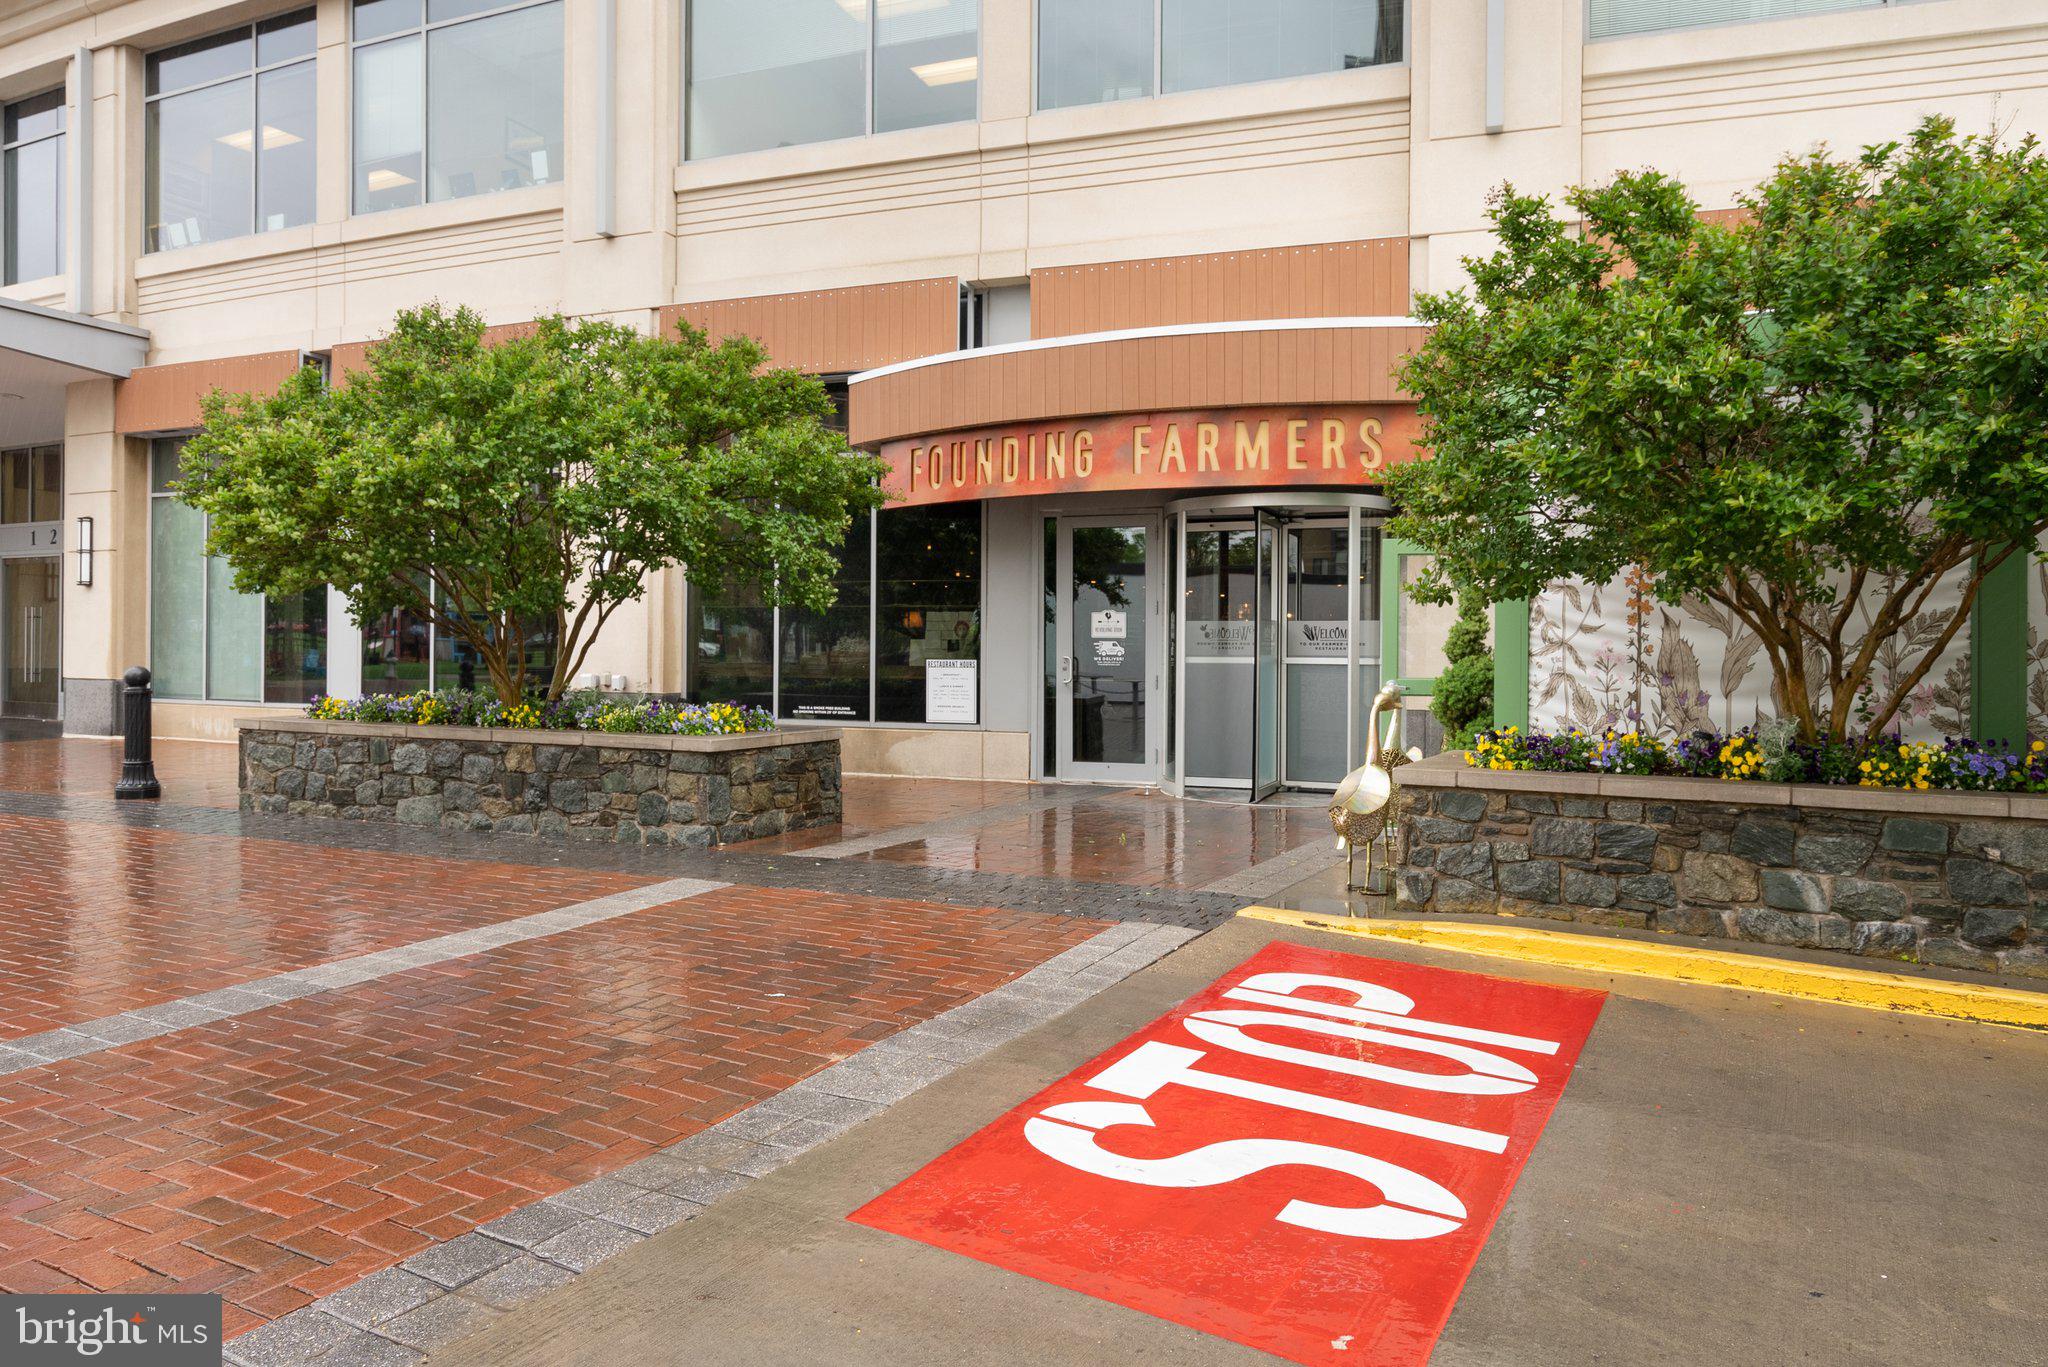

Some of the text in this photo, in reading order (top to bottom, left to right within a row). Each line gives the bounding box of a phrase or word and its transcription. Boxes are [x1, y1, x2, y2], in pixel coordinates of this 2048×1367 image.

[910, 416, 1385, 493] FOUNDING FARMERS
[1307, 625, 1348, 641] WELCOM
[927, 660, 976, 668] RESTAURANT HOURS
[1023, 972, 1561, 1240] STOP
